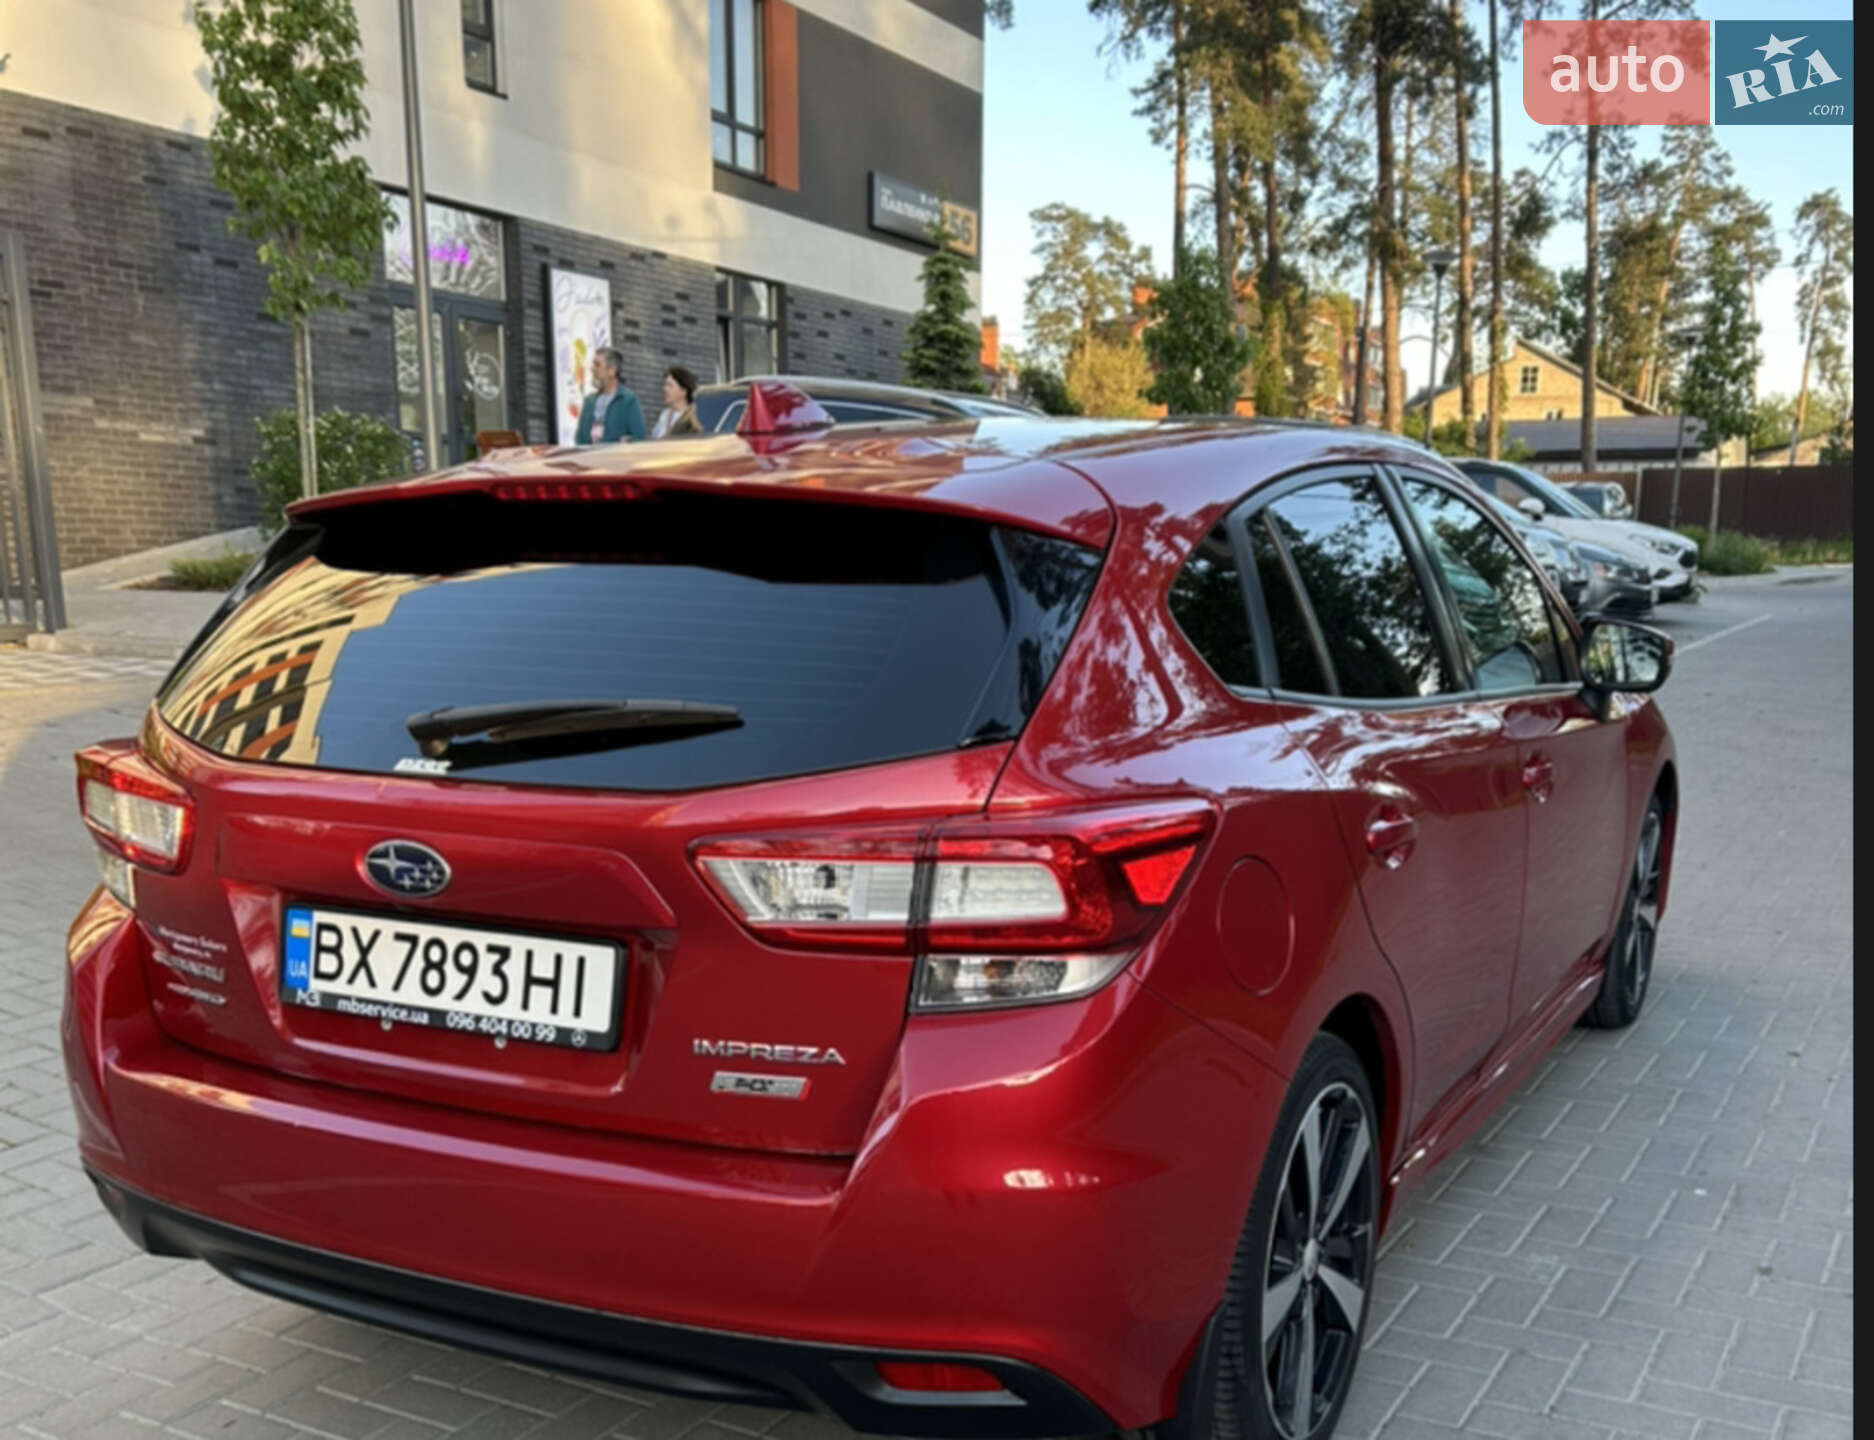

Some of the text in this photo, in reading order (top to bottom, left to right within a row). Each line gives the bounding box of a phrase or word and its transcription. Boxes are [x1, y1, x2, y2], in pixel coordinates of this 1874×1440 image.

[288, 958, 308, 979] UA
[337, 997, 557, 1043] mbservice.ua 096 404 00 99
[692, 1037, 847, 1066] IMPREZA
